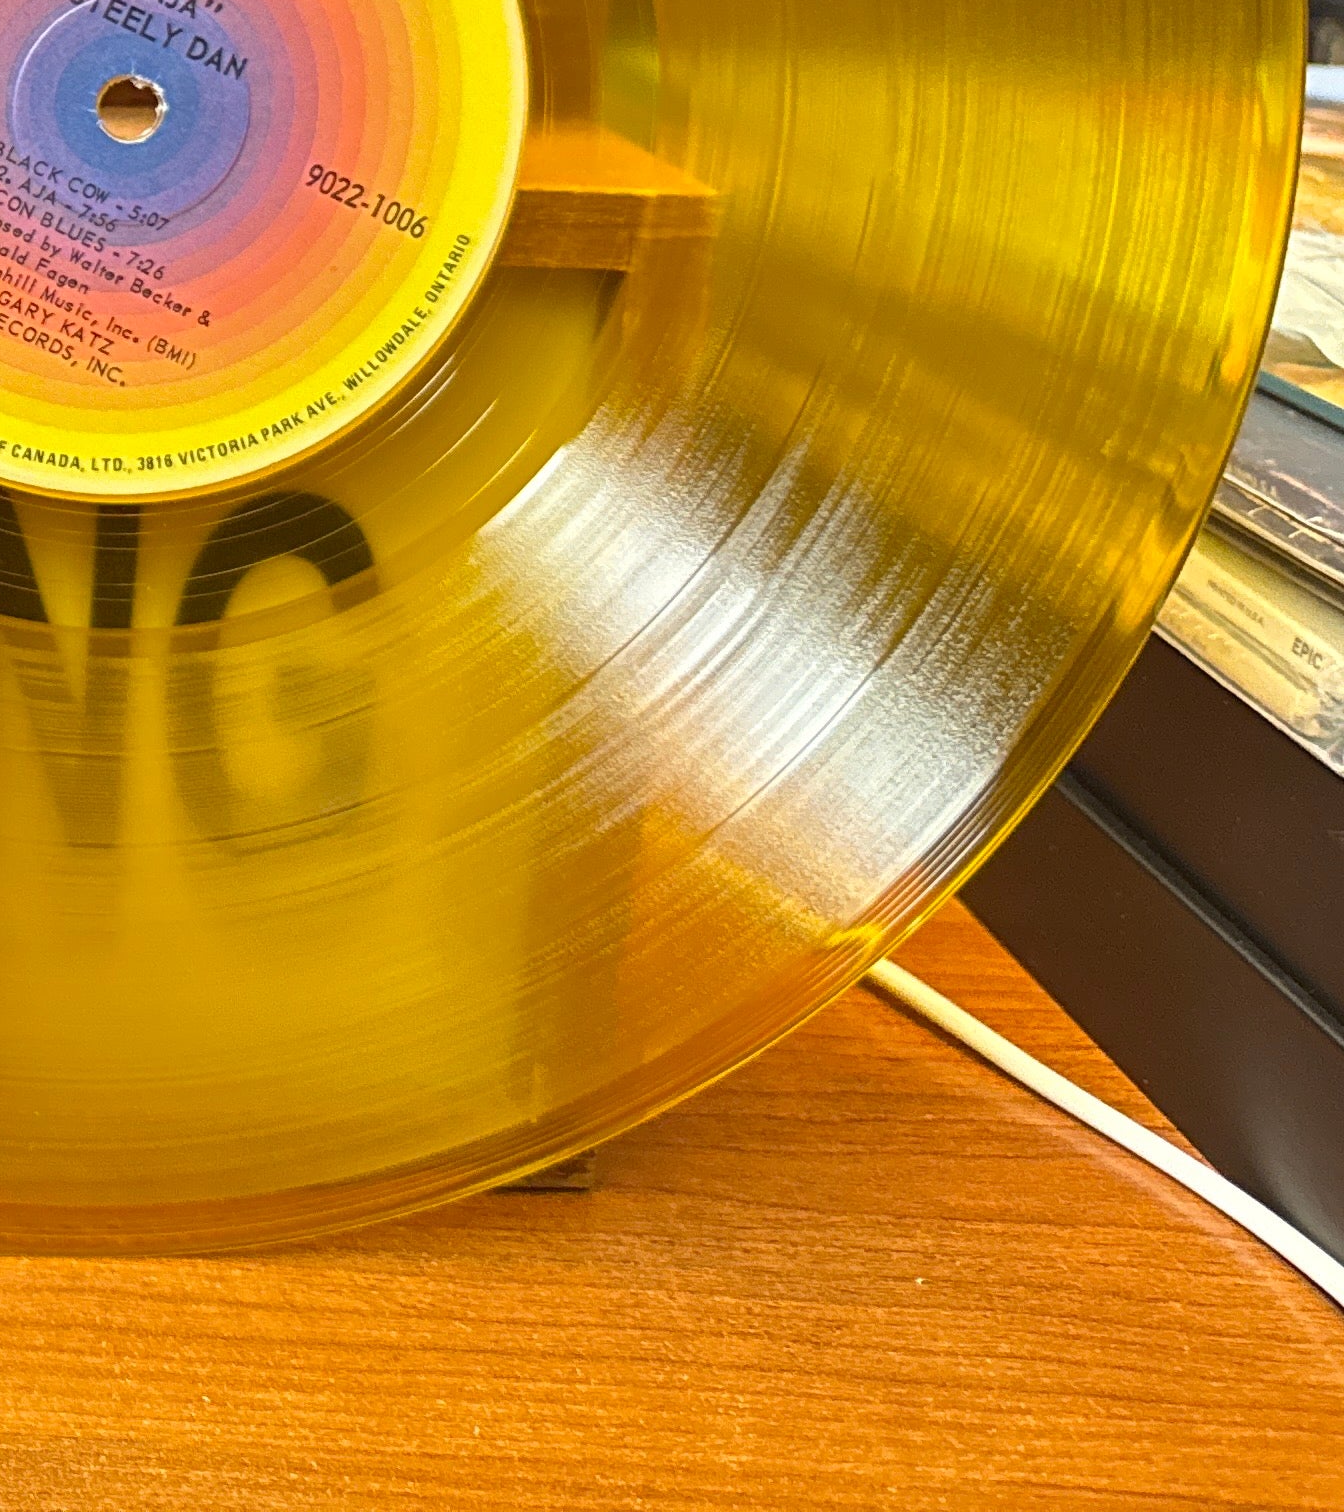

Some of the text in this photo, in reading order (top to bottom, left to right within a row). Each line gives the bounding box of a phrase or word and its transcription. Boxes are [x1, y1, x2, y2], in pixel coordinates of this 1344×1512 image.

[186, 35, 248, 81] DAN
[18, 178, 57, 205] AJA
[78, 203, 118, 233] 7:56
[68, 176, 111, 205] COW
[128, 204, 170, 232] 5:07
[305, 164, 429, 239] 9022-1006
[40, 212, 107, 253] BLUES
[126, 251, 166, 280] 7:26
[36, 260, 89, 295] Fagen
[40, 235, 61, 260] by
[70, 248, 124, 285] Walter
[130, 282, 192, 318] Becker
[197, 311, 210, 326] &
[11, 444, 86, 473] CANADA,
[137, 454, 173, 471] 3816
[178, 434, 259, 466] VICTORIA
[261, 412, 304, 442] PARK
[343, 306, 431, 392] WILLOWDALE,
[424, 233, 471, 304] ONTARIO
[40, 284, 98, 326] Music,
[106, 316, 139, 344] Inc.
[146, 335, 197, 370] (BMI)
[60, 318, 115, 356] KATZ
[86, 356, 126, 387] INC.
[1292, 637, 1323, 670] EPIC
